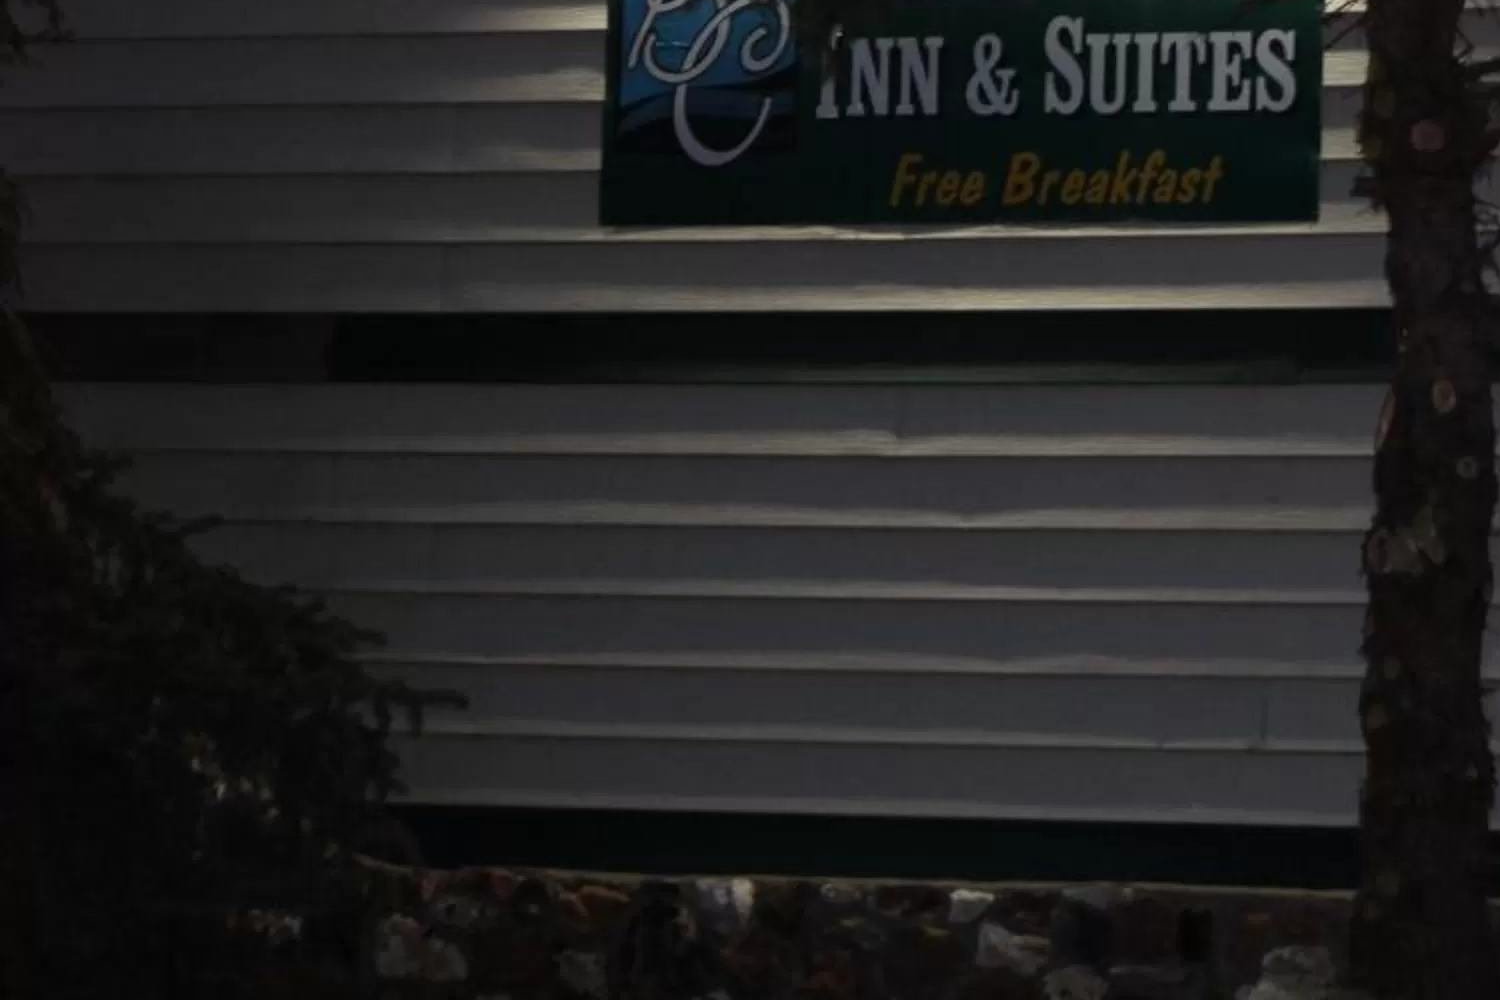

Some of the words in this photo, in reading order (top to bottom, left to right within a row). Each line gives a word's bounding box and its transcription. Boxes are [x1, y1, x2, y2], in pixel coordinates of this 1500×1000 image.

[965, 34, 1019, 116] &
[1044, 16, 1296, 115] SUITES
[890, 153, 984, 207] Free
[1003, 149, 1224, 206] Breakfast
